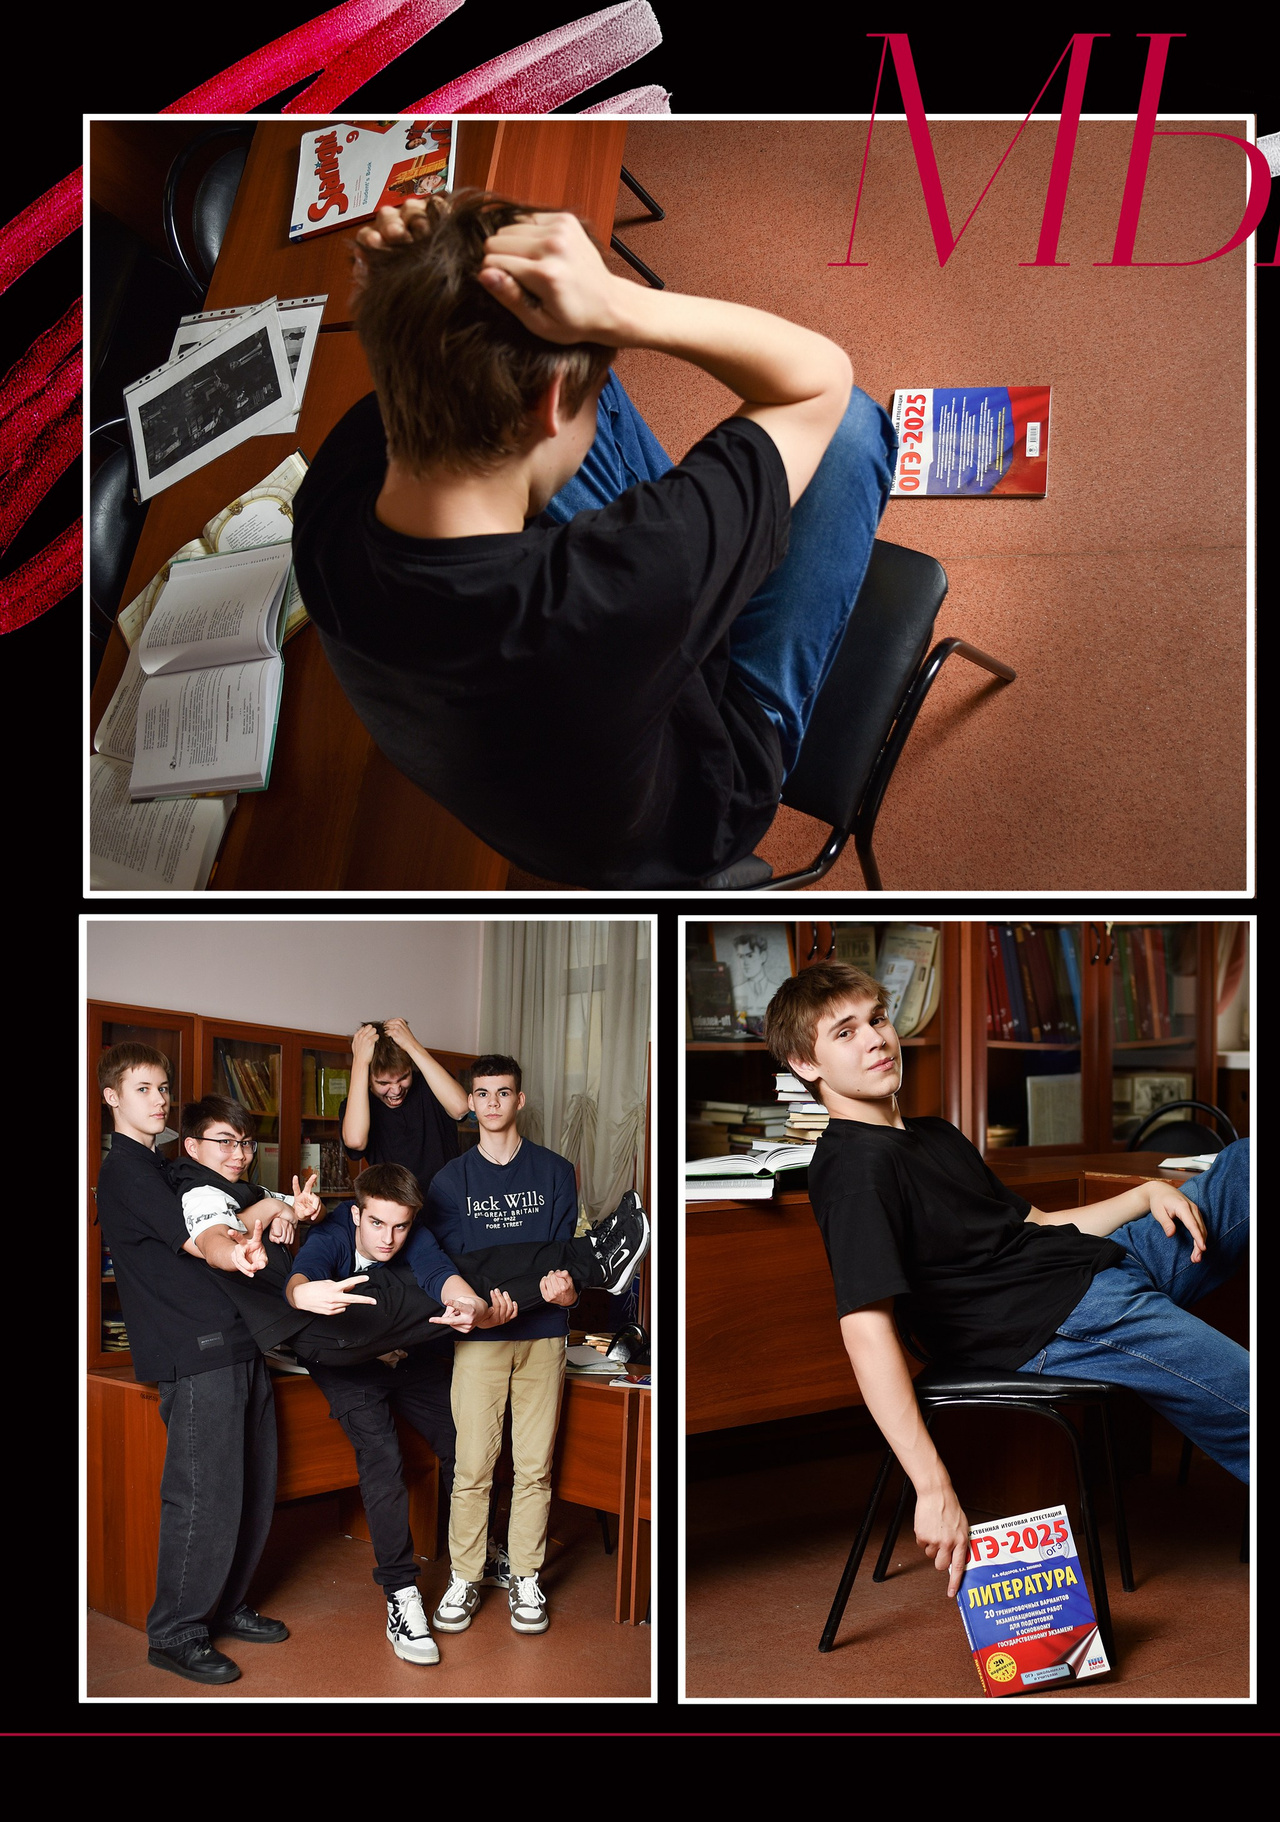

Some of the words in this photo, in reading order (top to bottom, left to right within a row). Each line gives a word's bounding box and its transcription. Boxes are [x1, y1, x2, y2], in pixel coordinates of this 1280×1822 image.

[346, 130, 360, 144] 9
[307, 130, 349, 222] Starlight
[899, 394, 927, 492] ОГЭ-2025
[466, 1196, 500, 1216] Jack
[504, 1191, 545, 1209] Wills
[511, 1207, 540, 1216] BRITAIN
[968, 1525, 1000, 1537] РСТВЕННАЯ
[1001, 1518, 1028, 1529] ИТОГОВАЯ
[1029, 1510, 1062, 1522] АТТЕСТАЦИЯ
[1046, 1542, 1063, 1557] ОГЭ
[967, 1566, 1079, 1609] ЛИТЕРАТУРА
[984, 1609, 995, 1619] 20
[995, 1602, 1040, 1616] ТРЕНИРОВОЧНЫХ
[1040, 1594, 1070, 1606] ВАРИАНТОВ
[995, 1609, 1047, 1626] ЭКЗАМЕНАЦИОННЫХ
[1047, 1604, 1063, 1614] РАБОТ
[1009, 1622, 1020, 1631] ДЛЯ
[1020, 1615, 1054, 1629] ПОДГОТОВКИ
[1021, 1623, 1051, 1635] ОСНОВНОМУ
[997, 1632, 1048, 1648] ГОСУДАРСТВЕННОМУ
[1048, 1625, 1074, 1637] ЭКЗАМЕНУ
[993, 1658, 1004, 1667] 20
